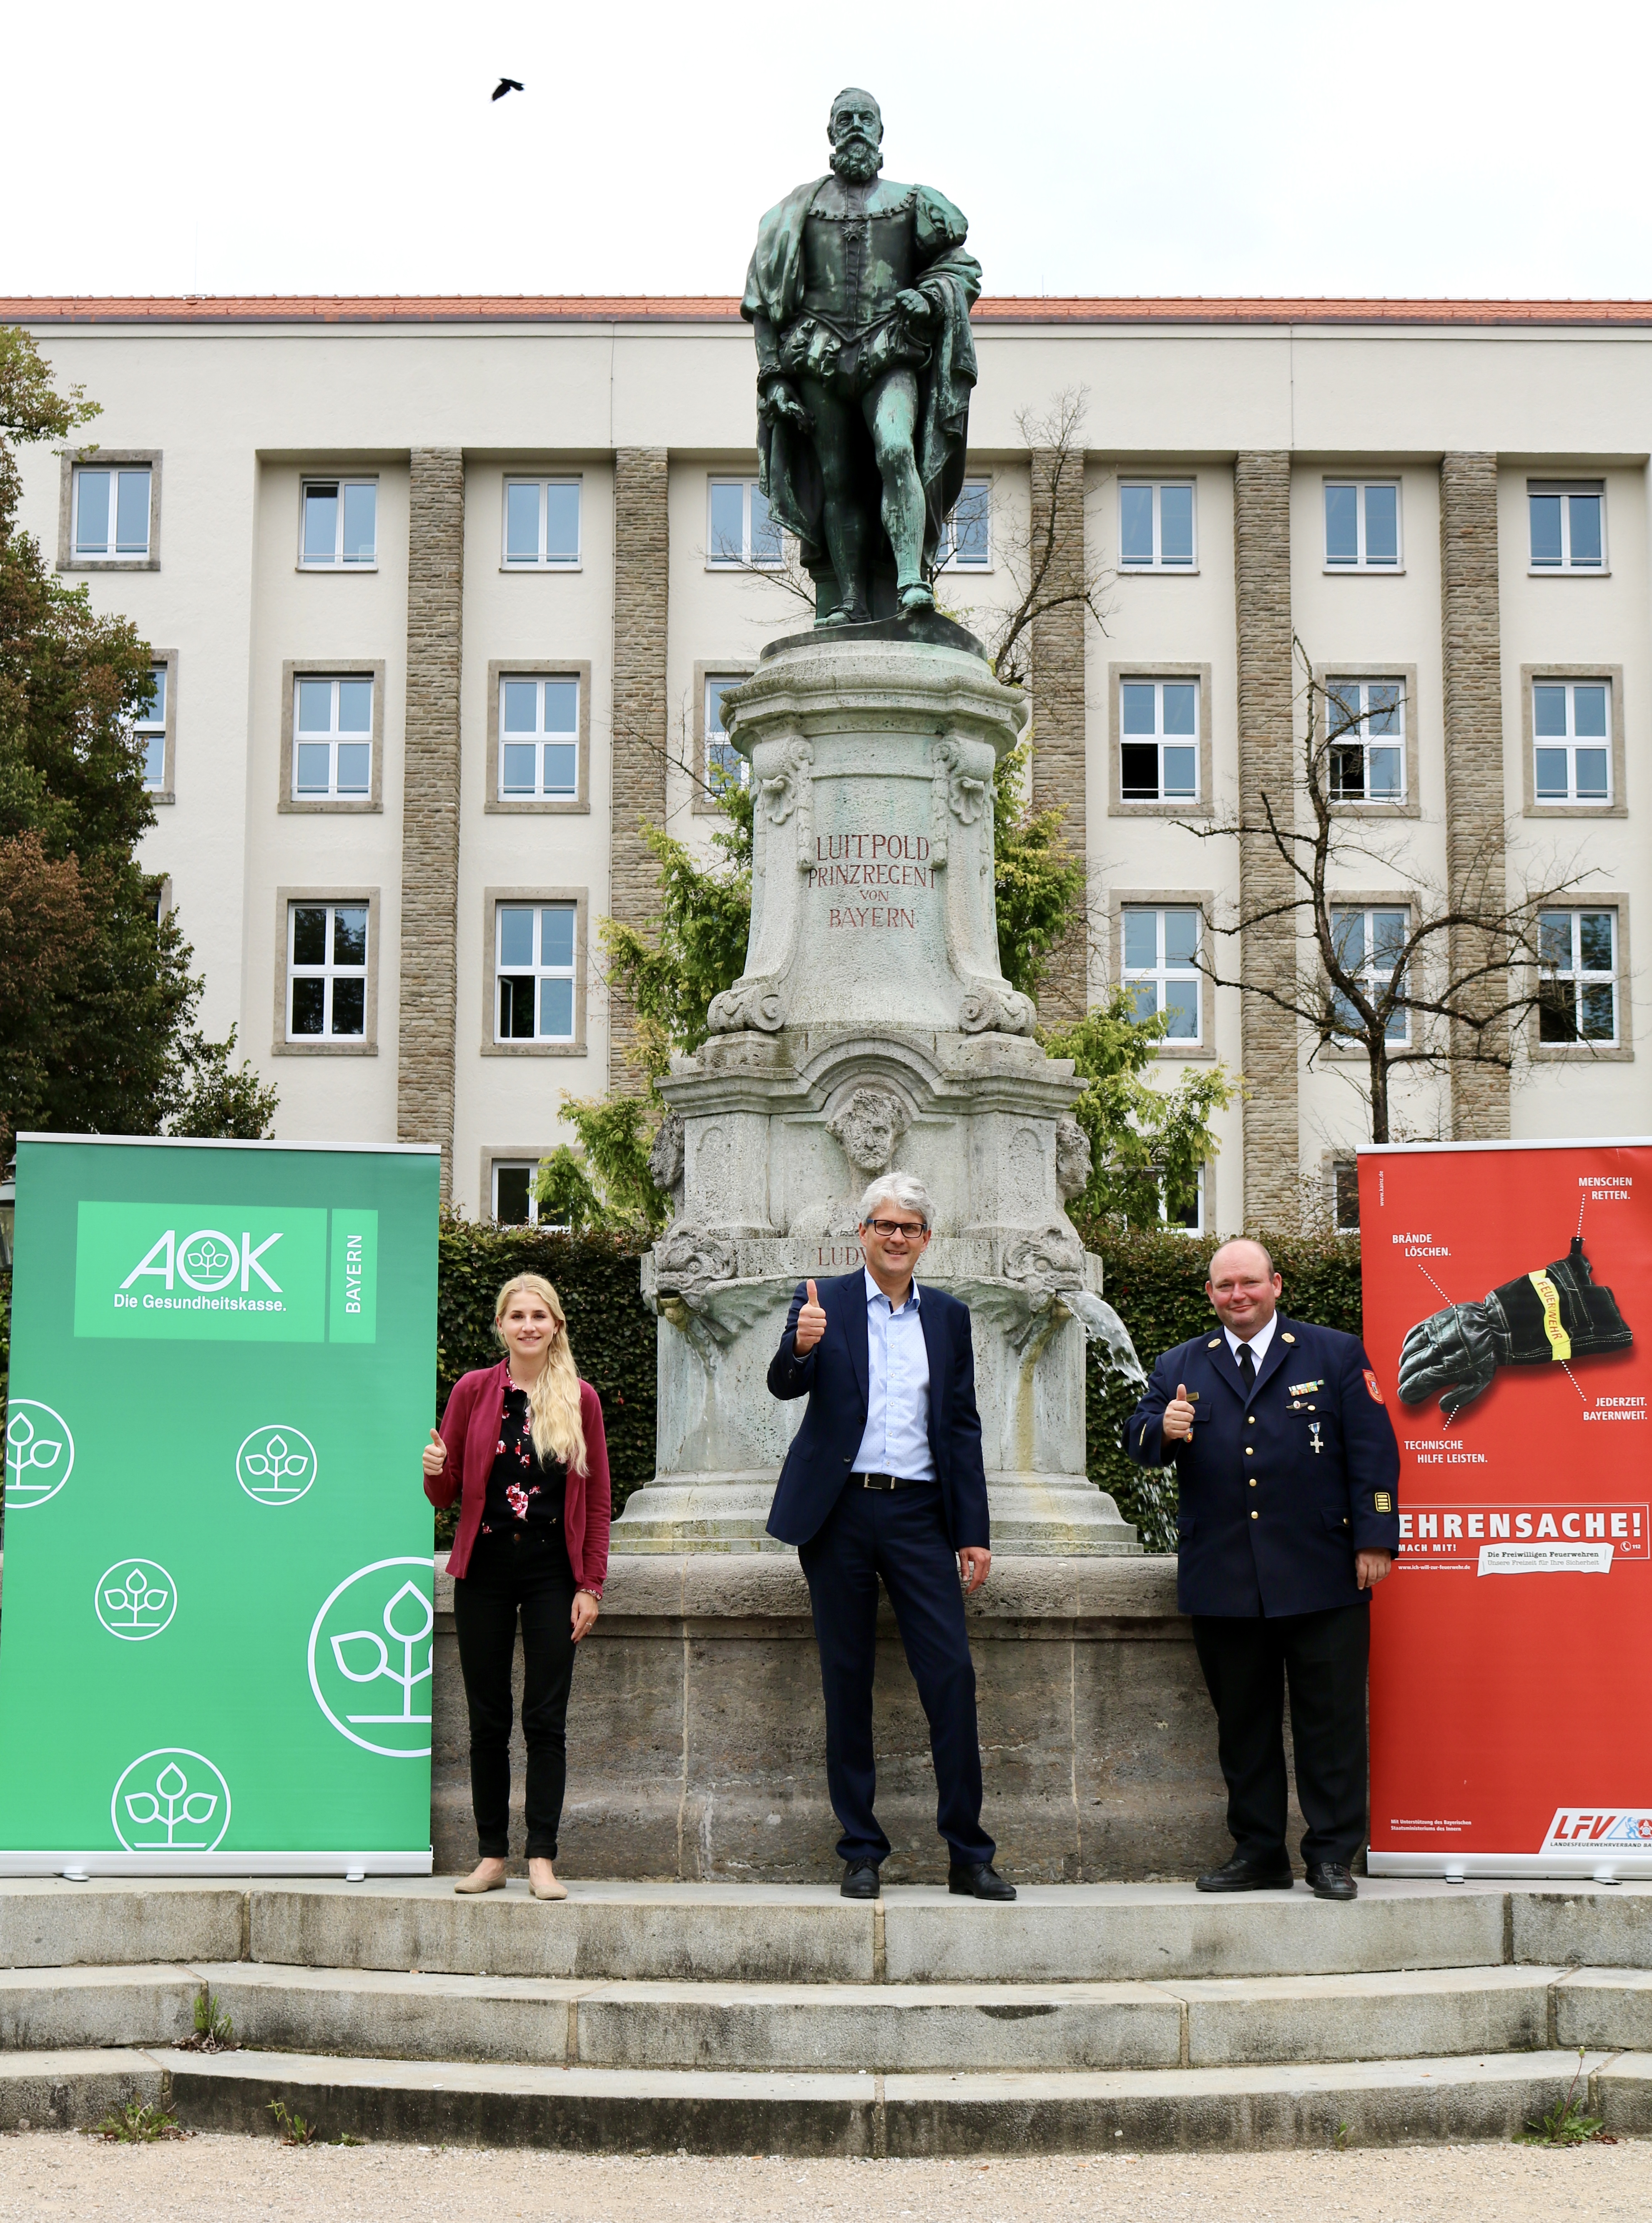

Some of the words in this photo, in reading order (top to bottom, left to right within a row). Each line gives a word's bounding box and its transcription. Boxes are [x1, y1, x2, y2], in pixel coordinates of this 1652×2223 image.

[817, 834, 929, 861] LUITPOLD
[808, 864, 936, 889] PRINZREGENT
[859, 890, 889, 902] VON
[829, 907, 915, 929] BAYERN
[1579, 1177, 1632, 1187] MENSCHEN
[1592, 1190, 1631, 1200] RETTEN.
[1392, 1232, 1432, 1244] BRÄNDE
[1405, 1245, 1451, 1257] LÖSCHEN.
[119, 1230, 284, 1293] AOK
[346, 1235, 362, 1313] BAYERN
[114, 1294, 138, 1308] Die
[143, 1294, 287, 1312] Gesundheitskasse.
[1537, 1281, 1563, 1340] FEUERWEHR
[1595, 1397, 1647, 1407] JEDERZEIT.
[1583, 1411, 1648, 1421] BAYERNWEIT.
[1404, 1440, 1464, 1450] TECHNISCHE
[1417, 1454, 1444, 1464] HILFE
[1447, 1454, 1488, 1463] LEISTEN.
[1398, 1513, 1641, 1538] EHRENSACHE!
[1553, 1816, 1617, 1839] LFV
